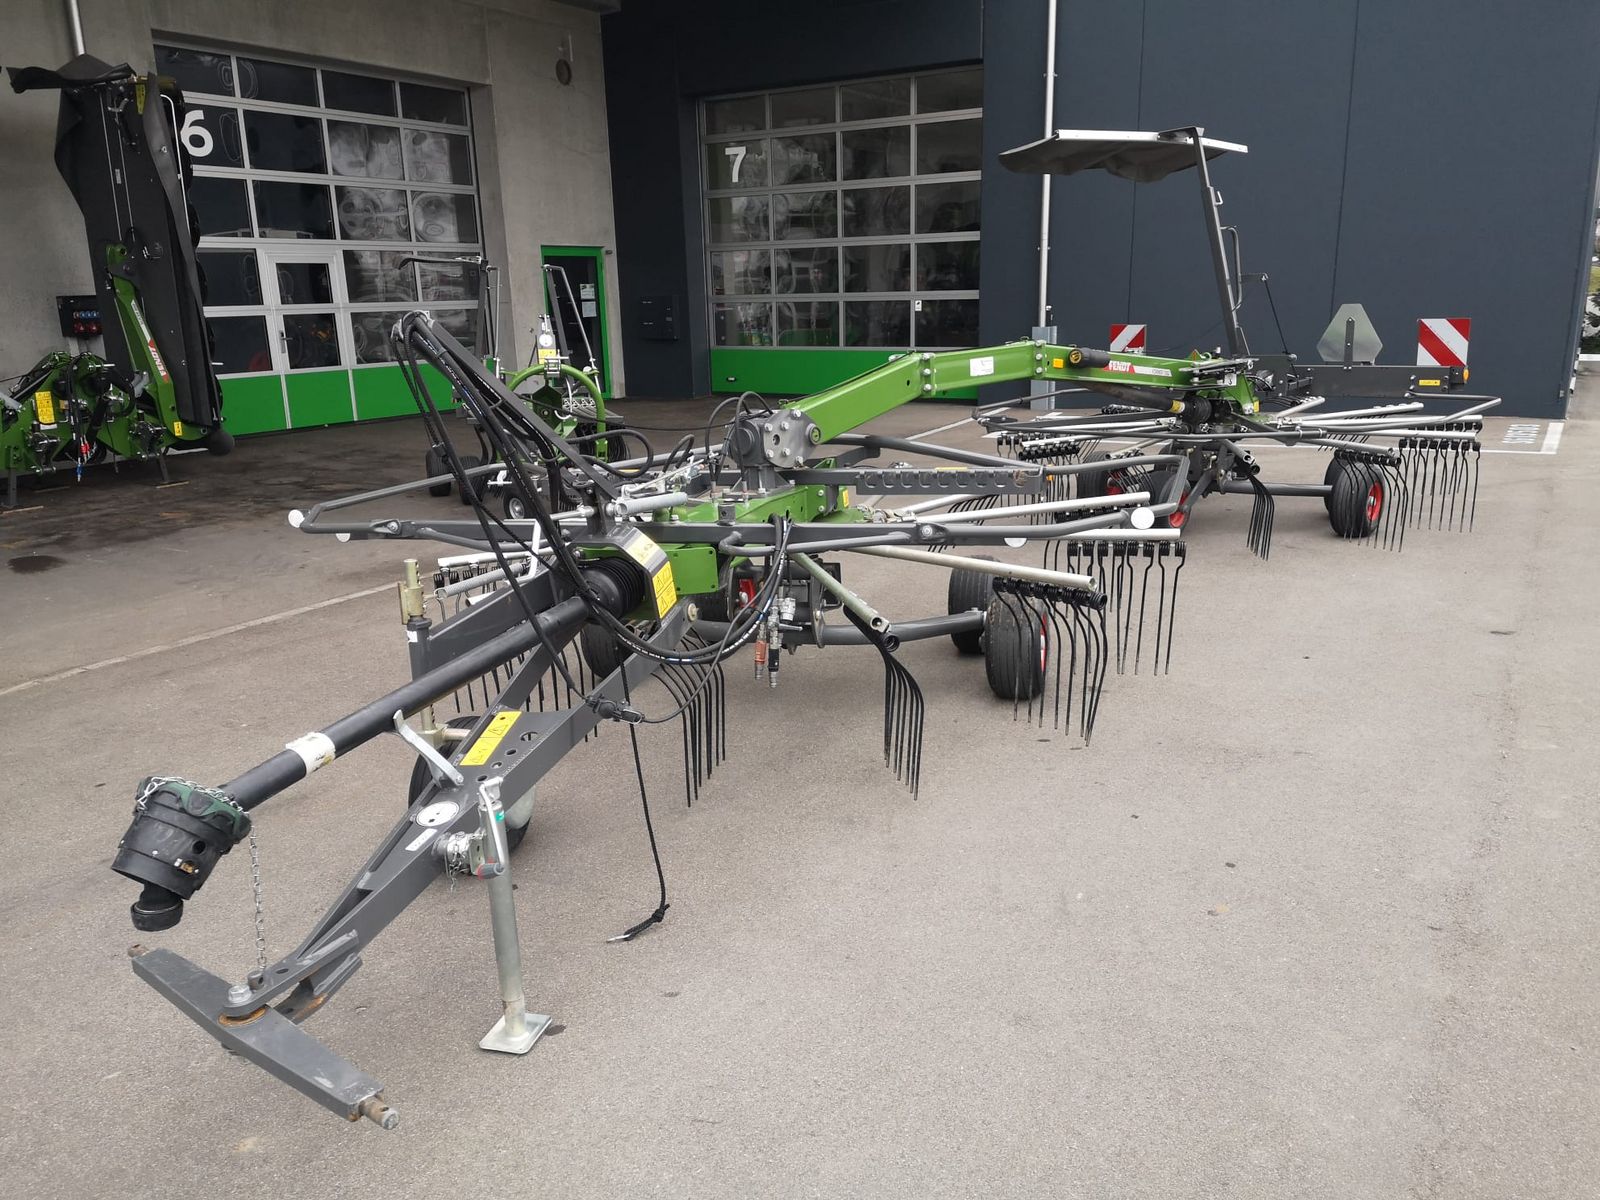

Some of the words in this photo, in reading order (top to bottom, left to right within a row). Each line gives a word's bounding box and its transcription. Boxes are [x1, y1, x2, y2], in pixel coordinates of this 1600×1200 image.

[180, 110, 213, 157] 6
[725, 146, 746, 183] 7
[148, 345, 167, 377] FENDT
[1109, 360, 1132, 372] FENDT
